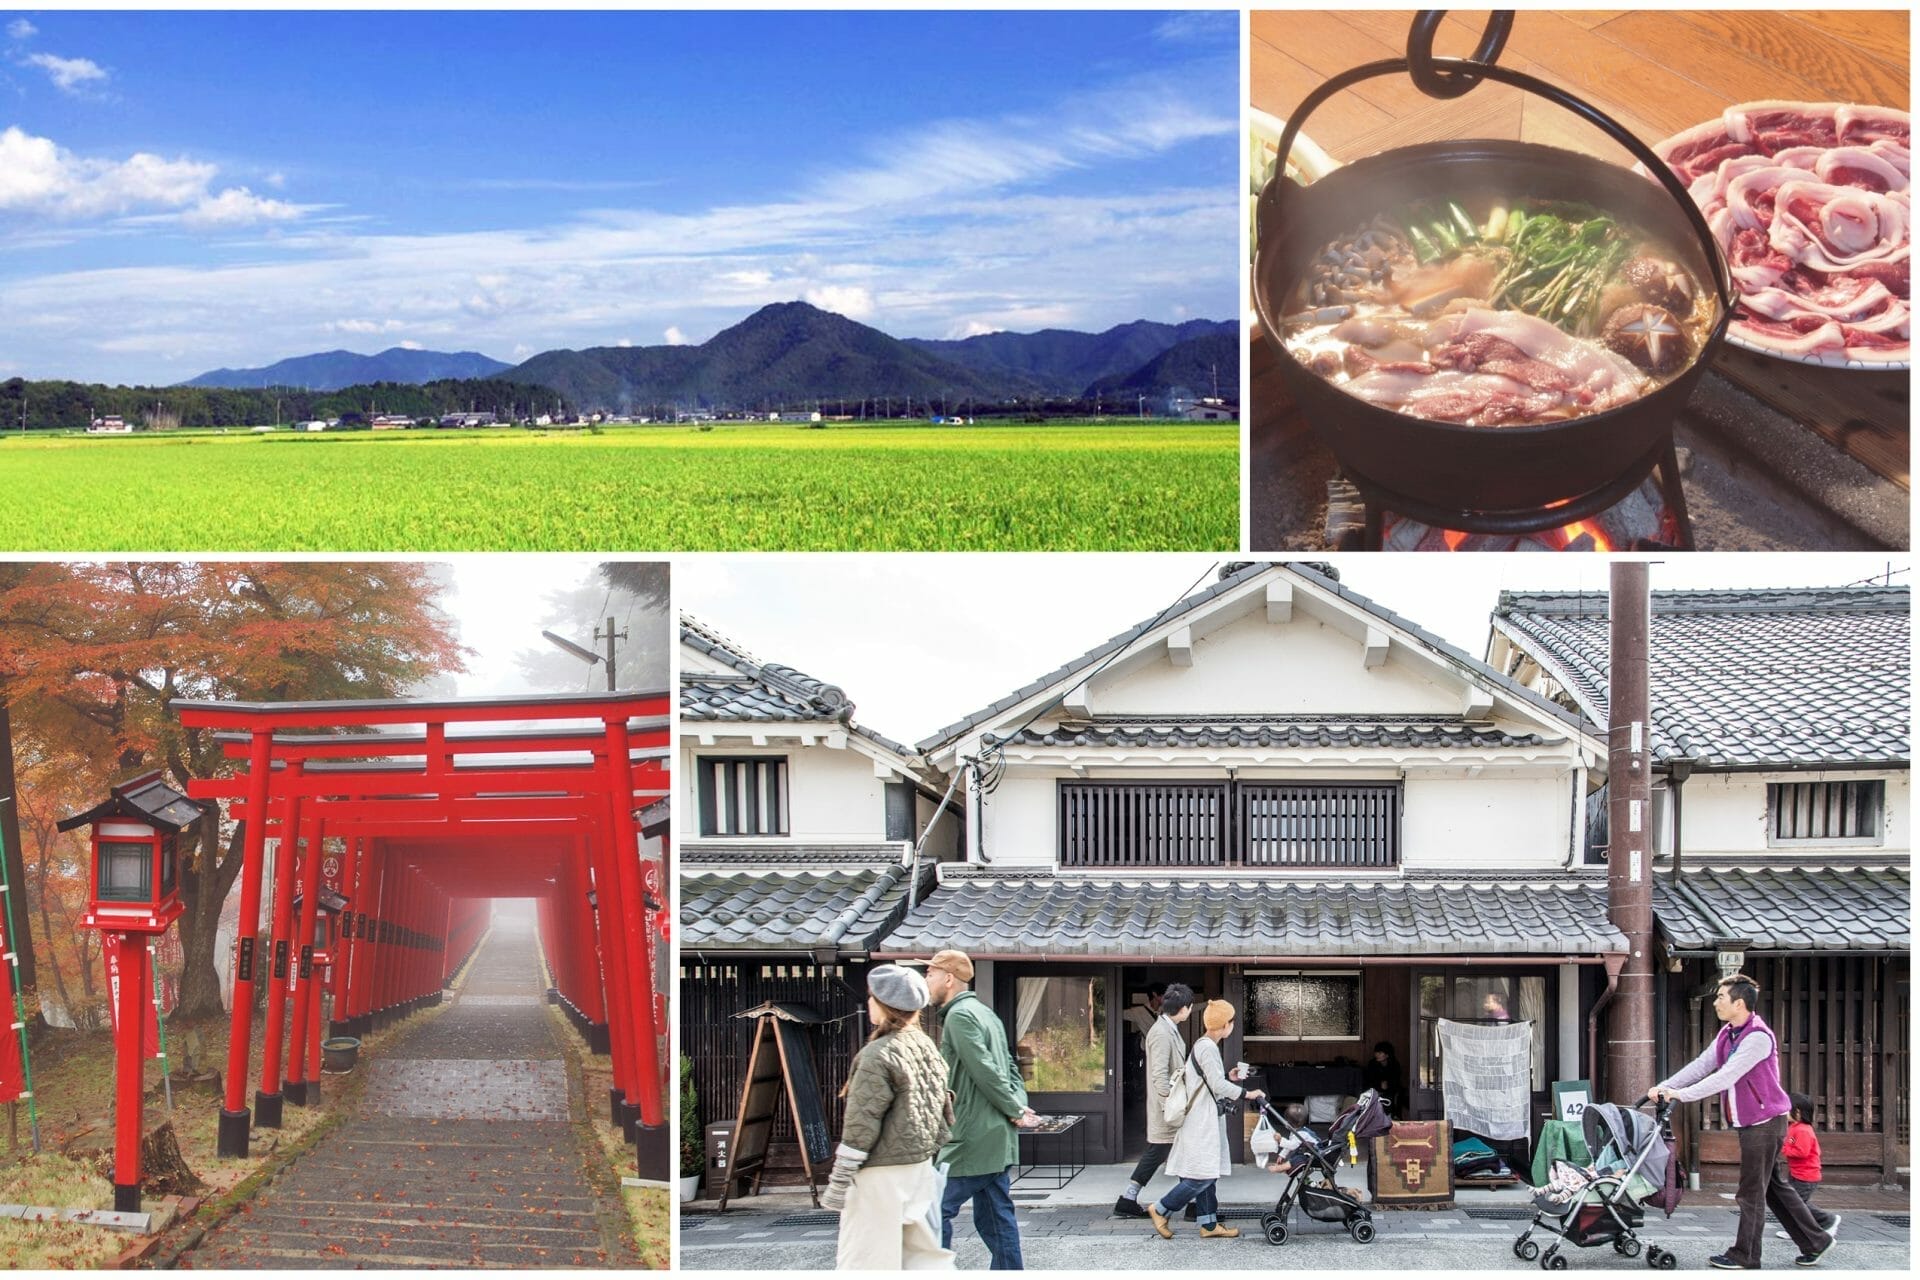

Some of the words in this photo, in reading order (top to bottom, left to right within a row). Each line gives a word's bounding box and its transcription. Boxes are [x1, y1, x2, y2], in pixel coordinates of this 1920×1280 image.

[1566, 1103, 1584, 1116] 42
[717, 1140, 727, 1168] 消火器
